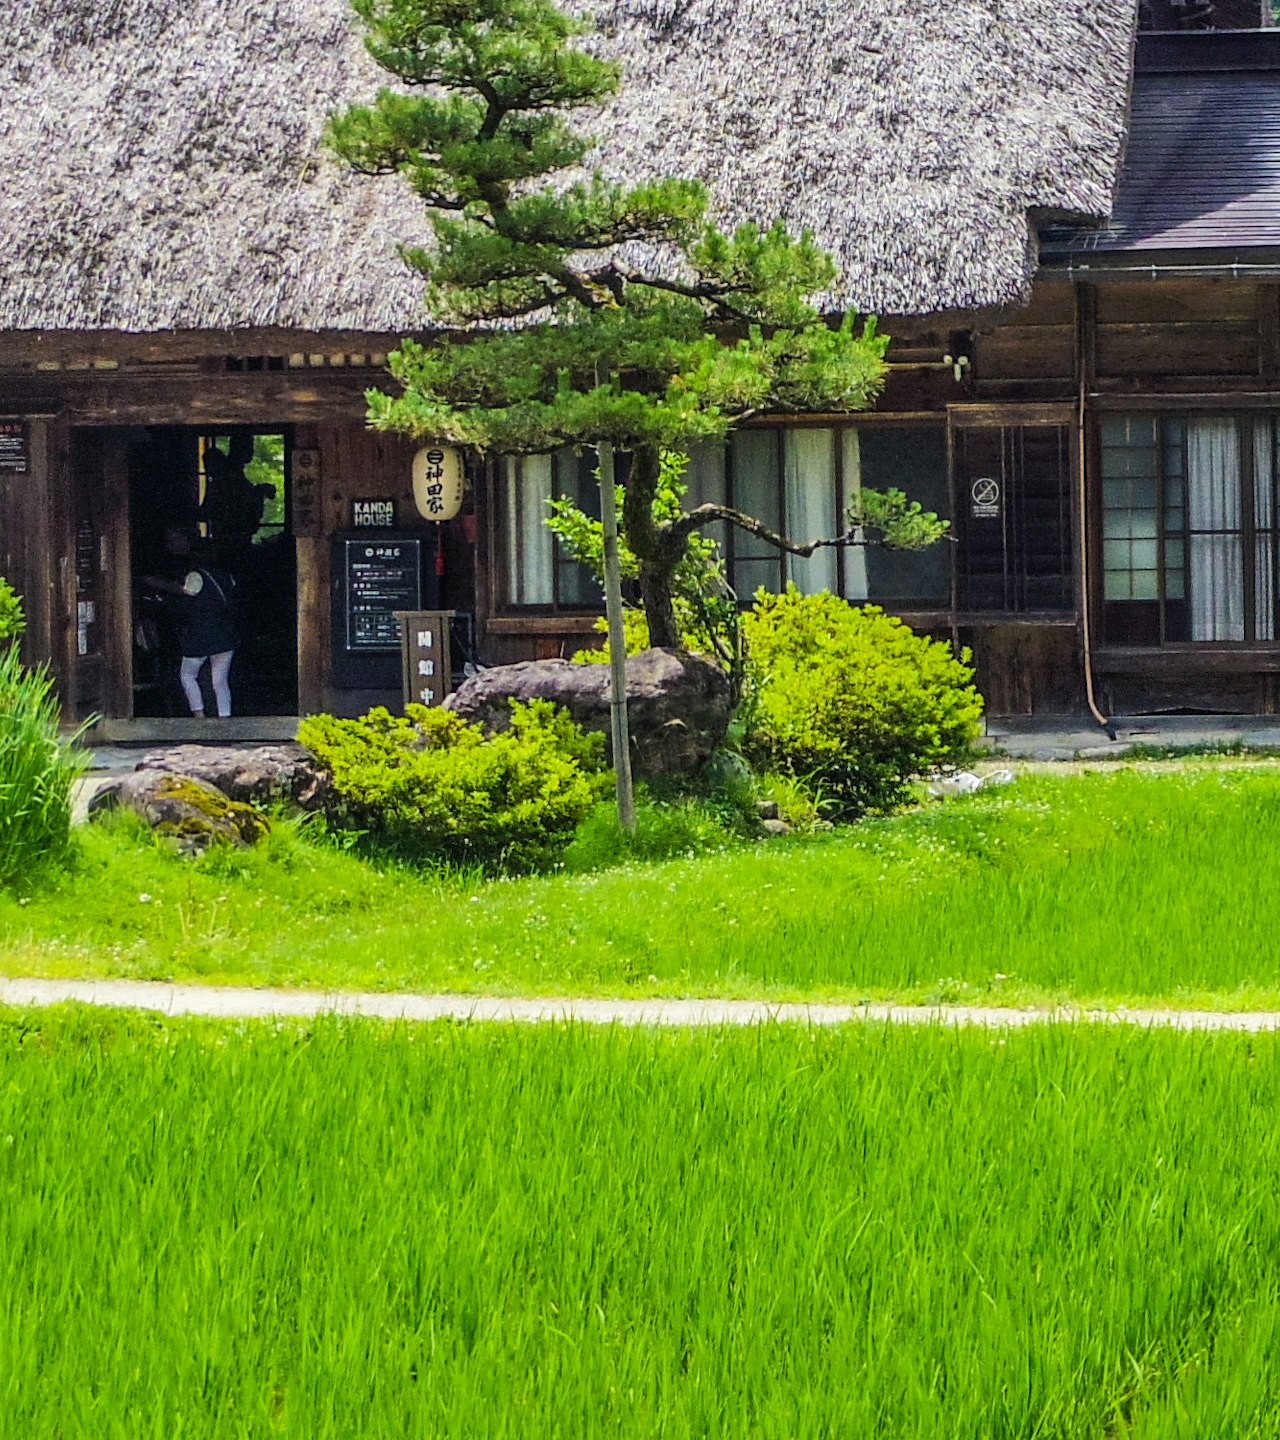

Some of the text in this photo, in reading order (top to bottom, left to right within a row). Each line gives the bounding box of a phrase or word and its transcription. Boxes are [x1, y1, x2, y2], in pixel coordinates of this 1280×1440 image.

[426, 465, 444, 514] 神田家
[354, 502, 393, 513] KANDA
[354, 514, 393, 526] HOUSE
